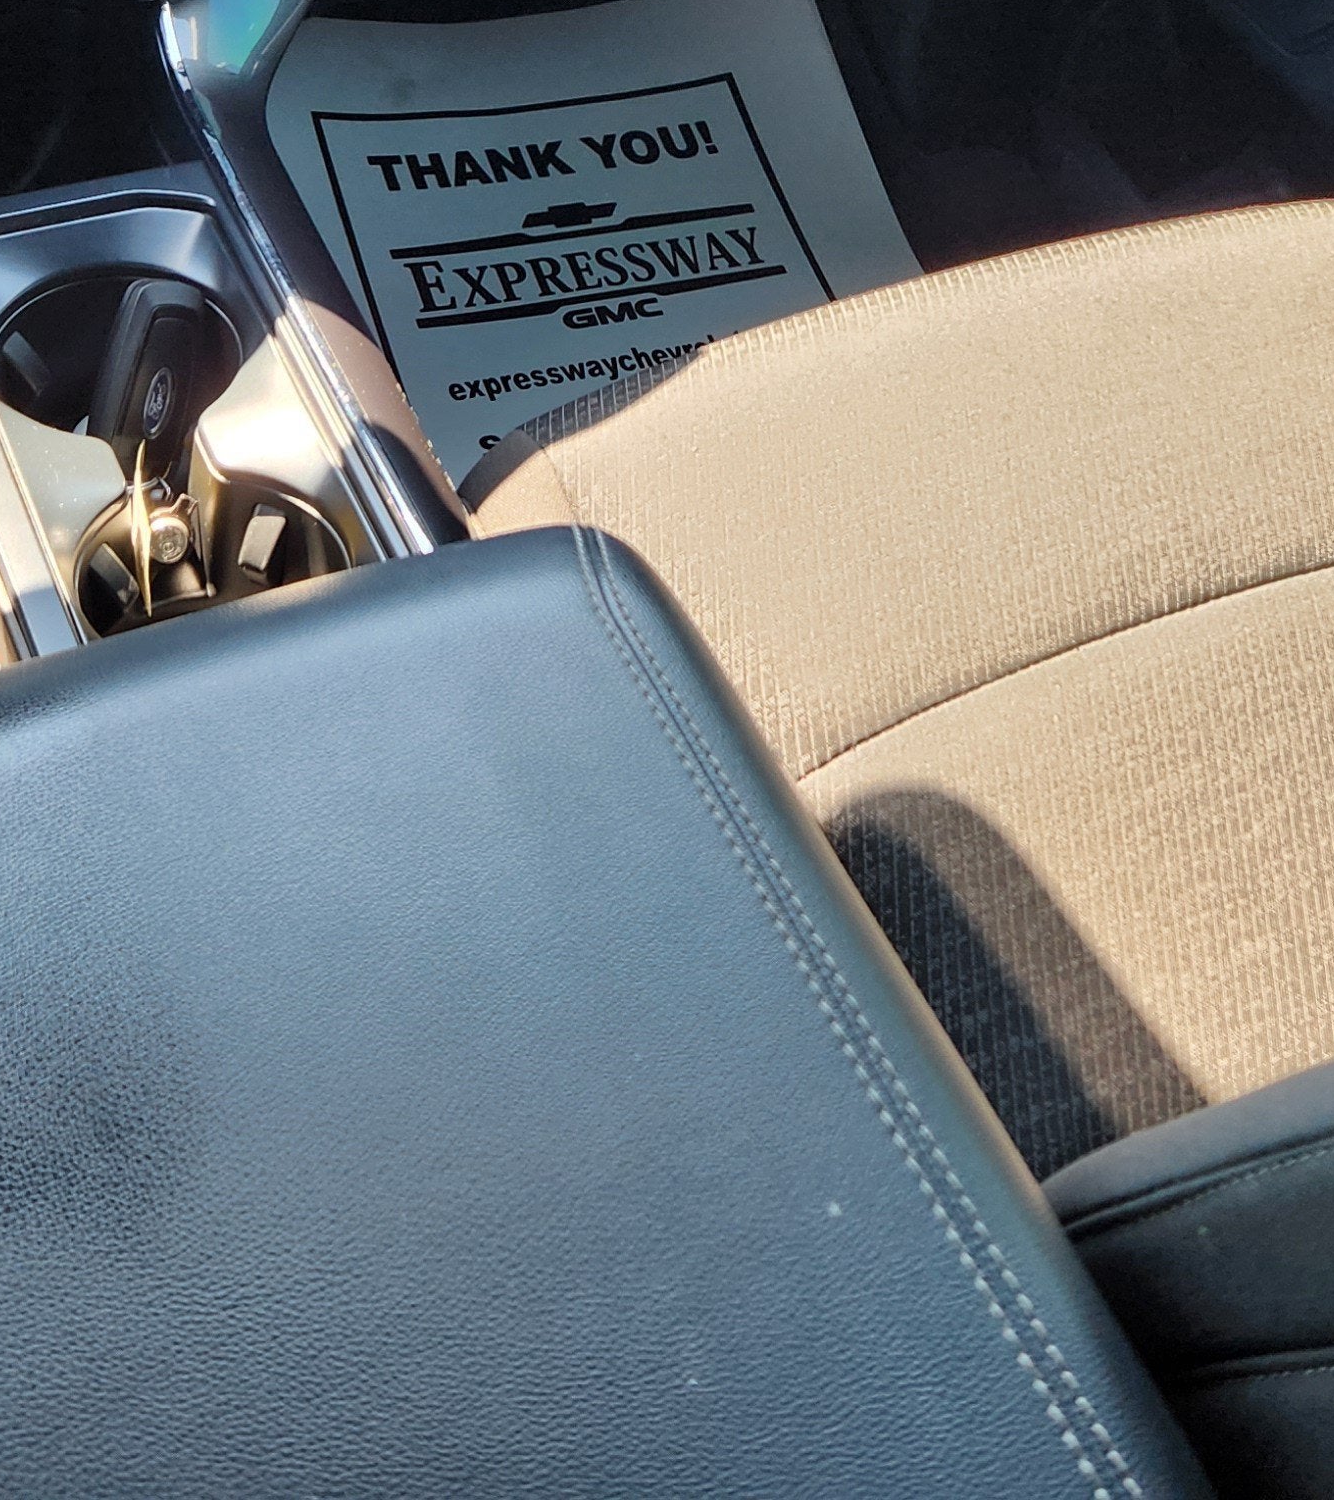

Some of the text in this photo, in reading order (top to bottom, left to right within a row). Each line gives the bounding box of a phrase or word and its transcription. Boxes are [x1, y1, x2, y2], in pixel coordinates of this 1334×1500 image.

[367, 120, 720, 191] THANK YOU!
[403, 226, 767, 314] EXPRESSWAY
[562, 298, 664, 330] GMC
[448, 330, 738, 402] expresswaychevr
